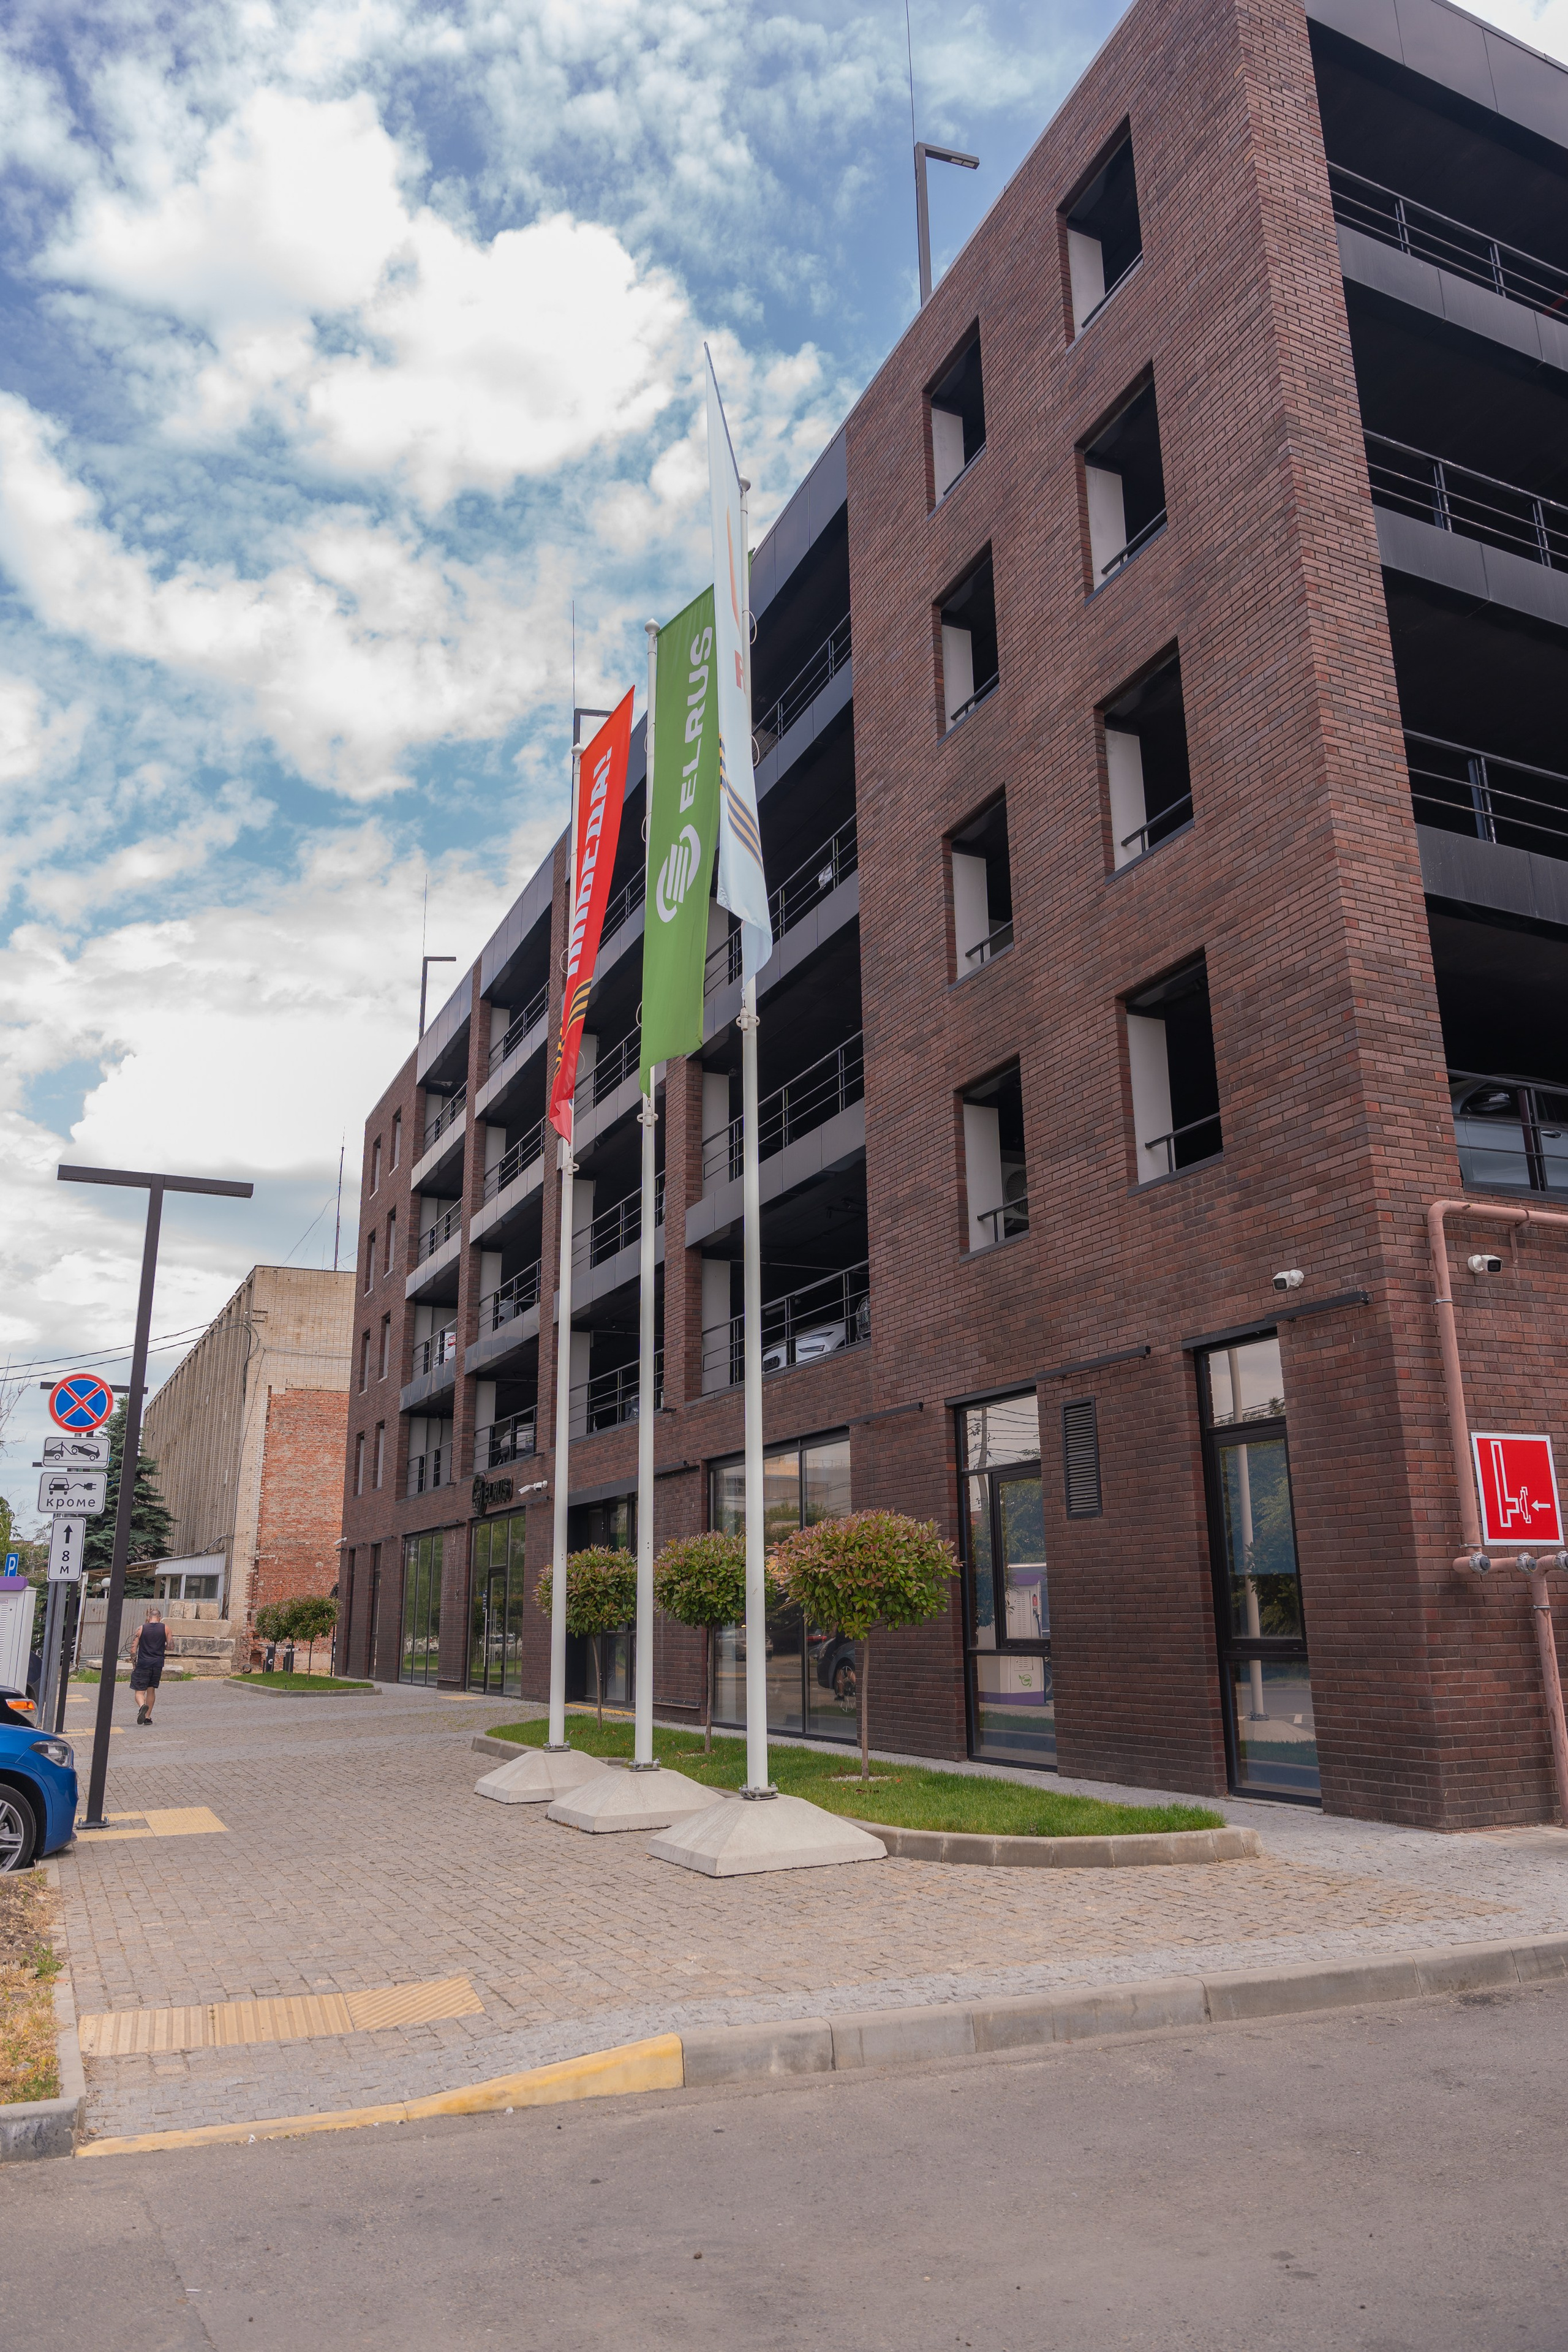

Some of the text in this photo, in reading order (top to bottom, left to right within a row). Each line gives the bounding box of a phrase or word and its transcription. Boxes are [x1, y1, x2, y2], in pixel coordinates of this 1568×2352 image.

[679, 627, 713, 813] ELRUS
[46, 1498, 96, 1510] кроме
[62, 1550, 70, 1561] 8
[7, 1556, 16, 1577] P
